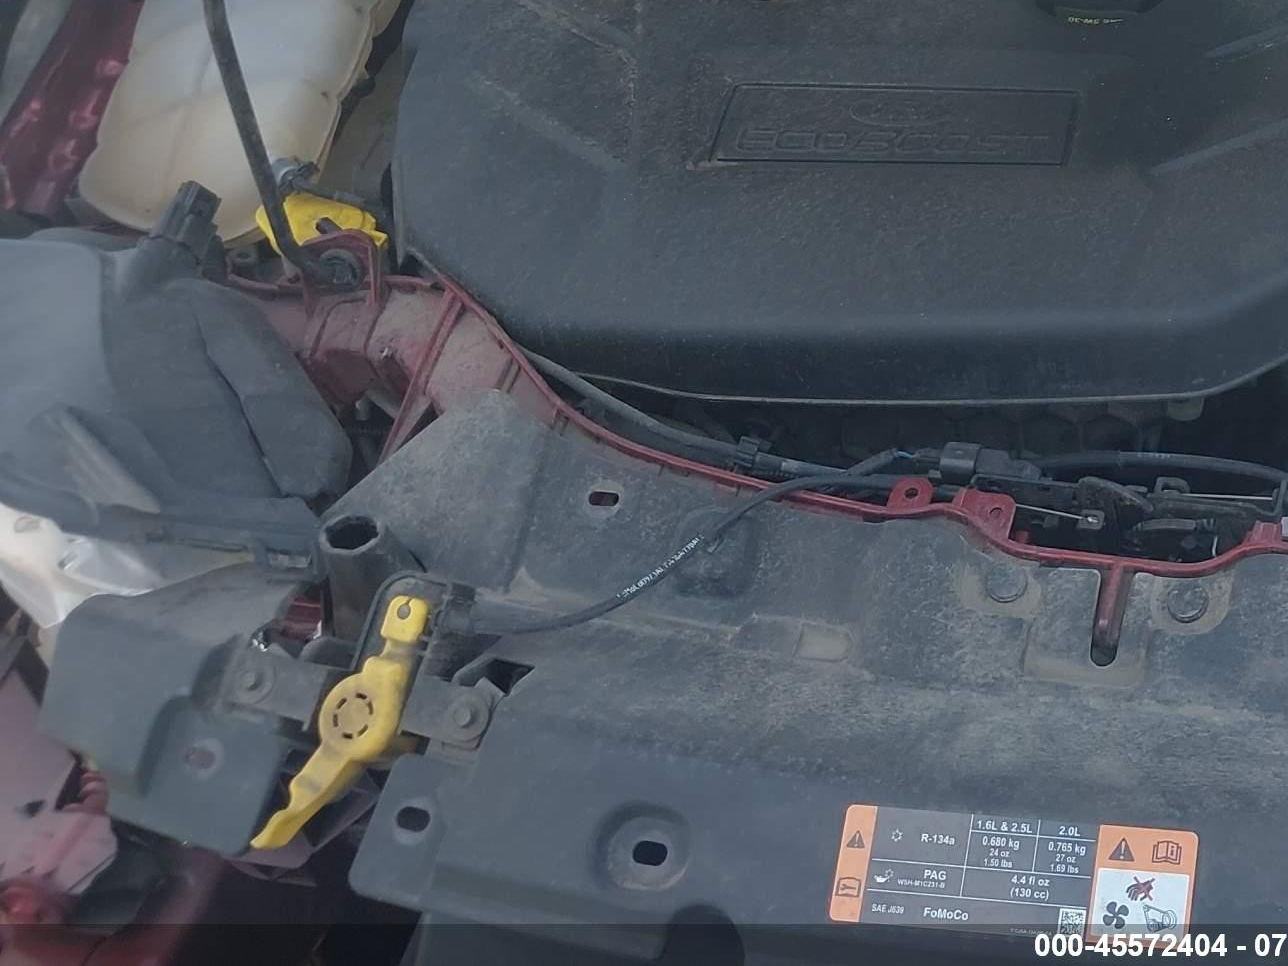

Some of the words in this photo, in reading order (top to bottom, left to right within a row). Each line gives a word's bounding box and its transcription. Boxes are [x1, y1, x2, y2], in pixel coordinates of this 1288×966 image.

[977, 819, 998, 831] 1.6L
[1000, 821, 1009, 832] &
[1010, 822, 1033, 834] 2.5L
[1058, 825, 1081, 837] 2.0L
[920, 833, 956, 846] R-134a
[982, 835, 1007, 847] 0.680
[1008, 837, 1020, 851] kg
[989, 848, 999, 857] 24
[1000, 850, 1010, 858] oz
[1048, 841, 1073, 853] 0.765
[1074, 842, 1087, 856] kg
[983, 858, 999, 867] 1.50
[1000, 859, 1013, 868] lbs
[1055, 853, 1065, 863] 27
[1066, 856, 1077, 864] oz
[1049, 863, 1066, 873] 1.69
[1067, 864, 1080, 874] lbs
[923, 869, 947, 881] PAG
[1011, 874, 1027, 885] 4.4
[1028, 875, 1036, 886] fl
[1037, 878, 1050, 887] oz
[1010, 886, 1031, 899] (130
[1033, 889, 1049, 902] cc)
[871, 903, 887, 914] SAE
[922, 906, 969, 922] FoMoCo
